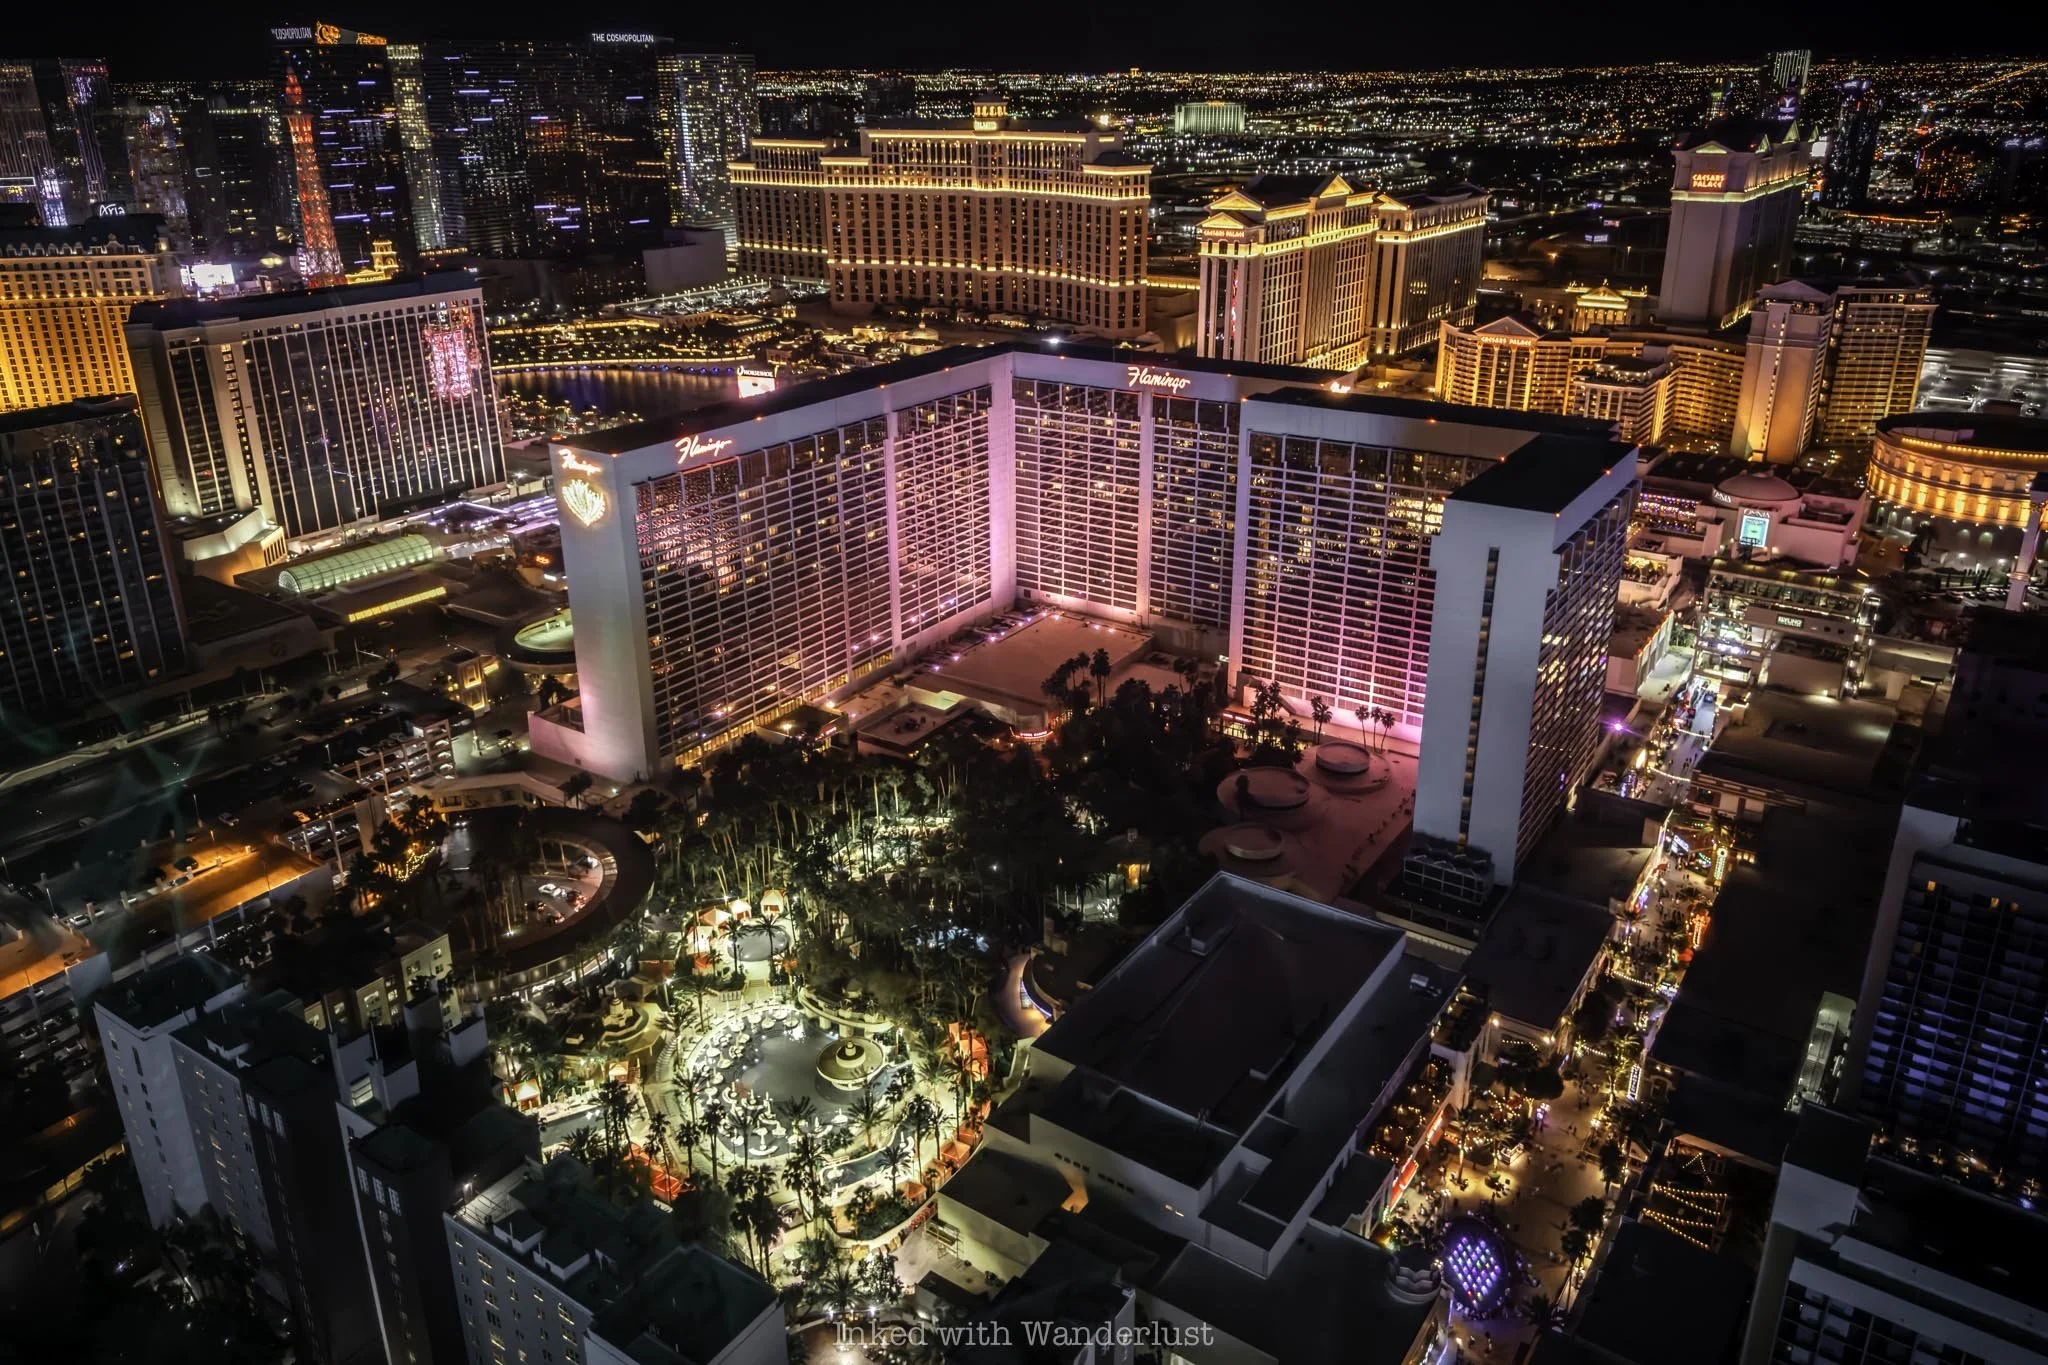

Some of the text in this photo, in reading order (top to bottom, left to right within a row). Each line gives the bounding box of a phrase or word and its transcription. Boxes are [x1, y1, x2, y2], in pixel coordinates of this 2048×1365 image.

[592, 33, 654, 43] THE COSMOPOLITAN
[1692, 174, 1725, 182] CAESARS
[1127, 366, 1191, 394] Flamingo
[675, 435, 733, 465] Flamingo
